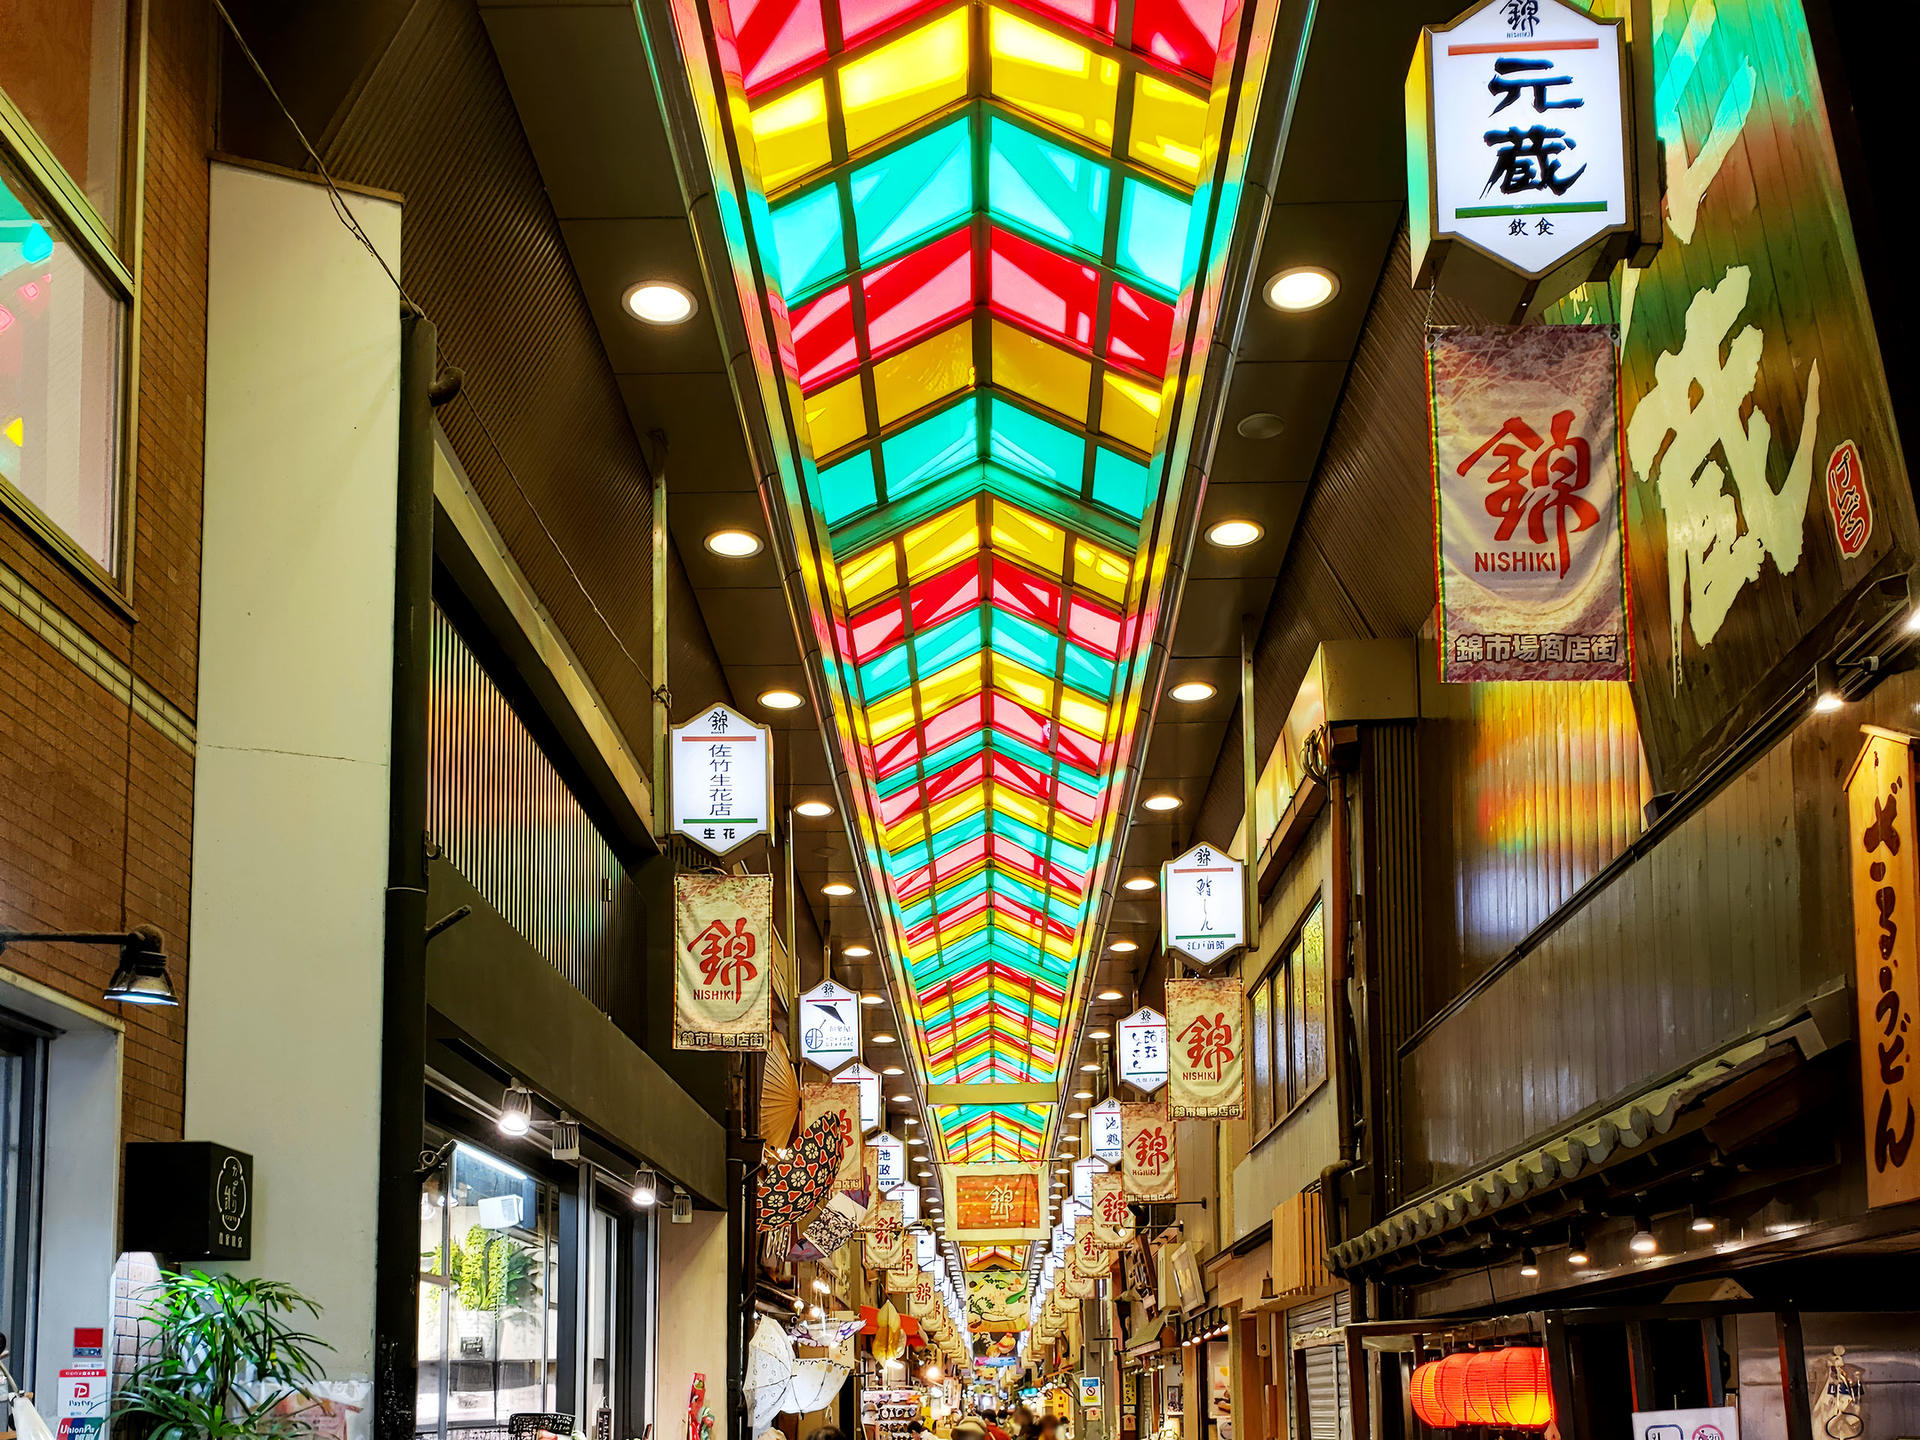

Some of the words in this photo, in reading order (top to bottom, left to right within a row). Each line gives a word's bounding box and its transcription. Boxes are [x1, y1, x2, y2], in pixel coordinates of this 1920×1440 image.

[1499, 0, 1541, 37] 錦
[1478, 57, 1588, 197] 元蔵
[1508, 215, 1555, 237] 飲食
[1456, 410, 1601, 579] 錦
[1474, 551, 1558, 572] NISHIKI
[1454, 633, 1617, 663] 錦市場商店街
[707, 710, 729, 734] 錦
[708, 743, 734, 817] 佐竹生花店
[703, 827, 736, 840] 生花
[687, 916, 759, 1004] 錦
[693, 988, 736, 1001] NISHIKI
[1176, 1012, 1236, 1083] 錦
[1182, 1071, 1217, 1081] NISHIKI
[1127, 1126, 1169, 1176] 錦
[984, 1184, 1015, 1219] 錦
[1097, 1190, 1129, 1228] 錦
